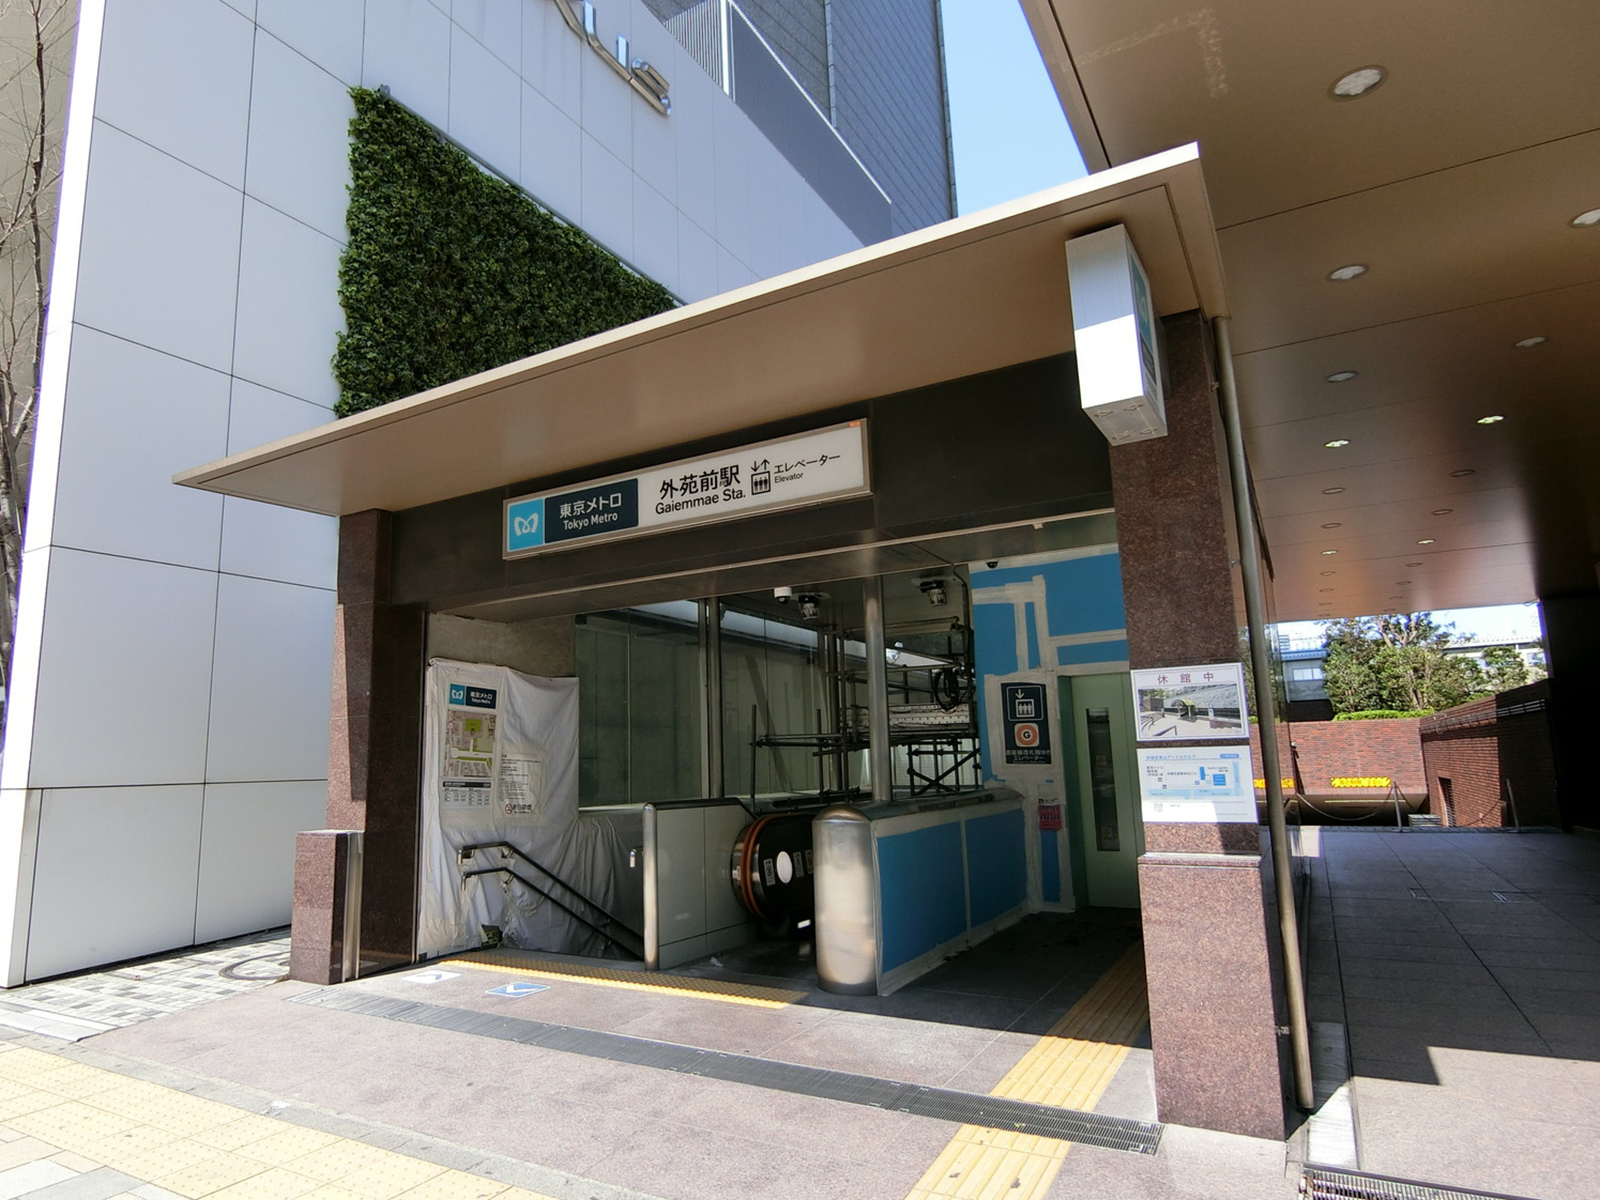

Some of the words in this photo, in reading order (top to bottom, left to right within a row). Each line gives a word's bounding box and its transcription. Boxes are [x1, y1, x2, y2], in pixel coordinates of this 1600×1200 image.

[774, 454, 841, 474] エレベーター
[659, 465, 741, 500] 外苑前駅
[774, 472, 804, 484] Elevator
[560, 493, 621, 518] 東京メトロ
[655, 494, 719, 515] Gaiemmae
[722, 488, 746, 502] Sta.
[563, 519, 589, 530] Tokyo
[591, 513, 618, 525] Metro
[1023, 731, 1031, 739] G
